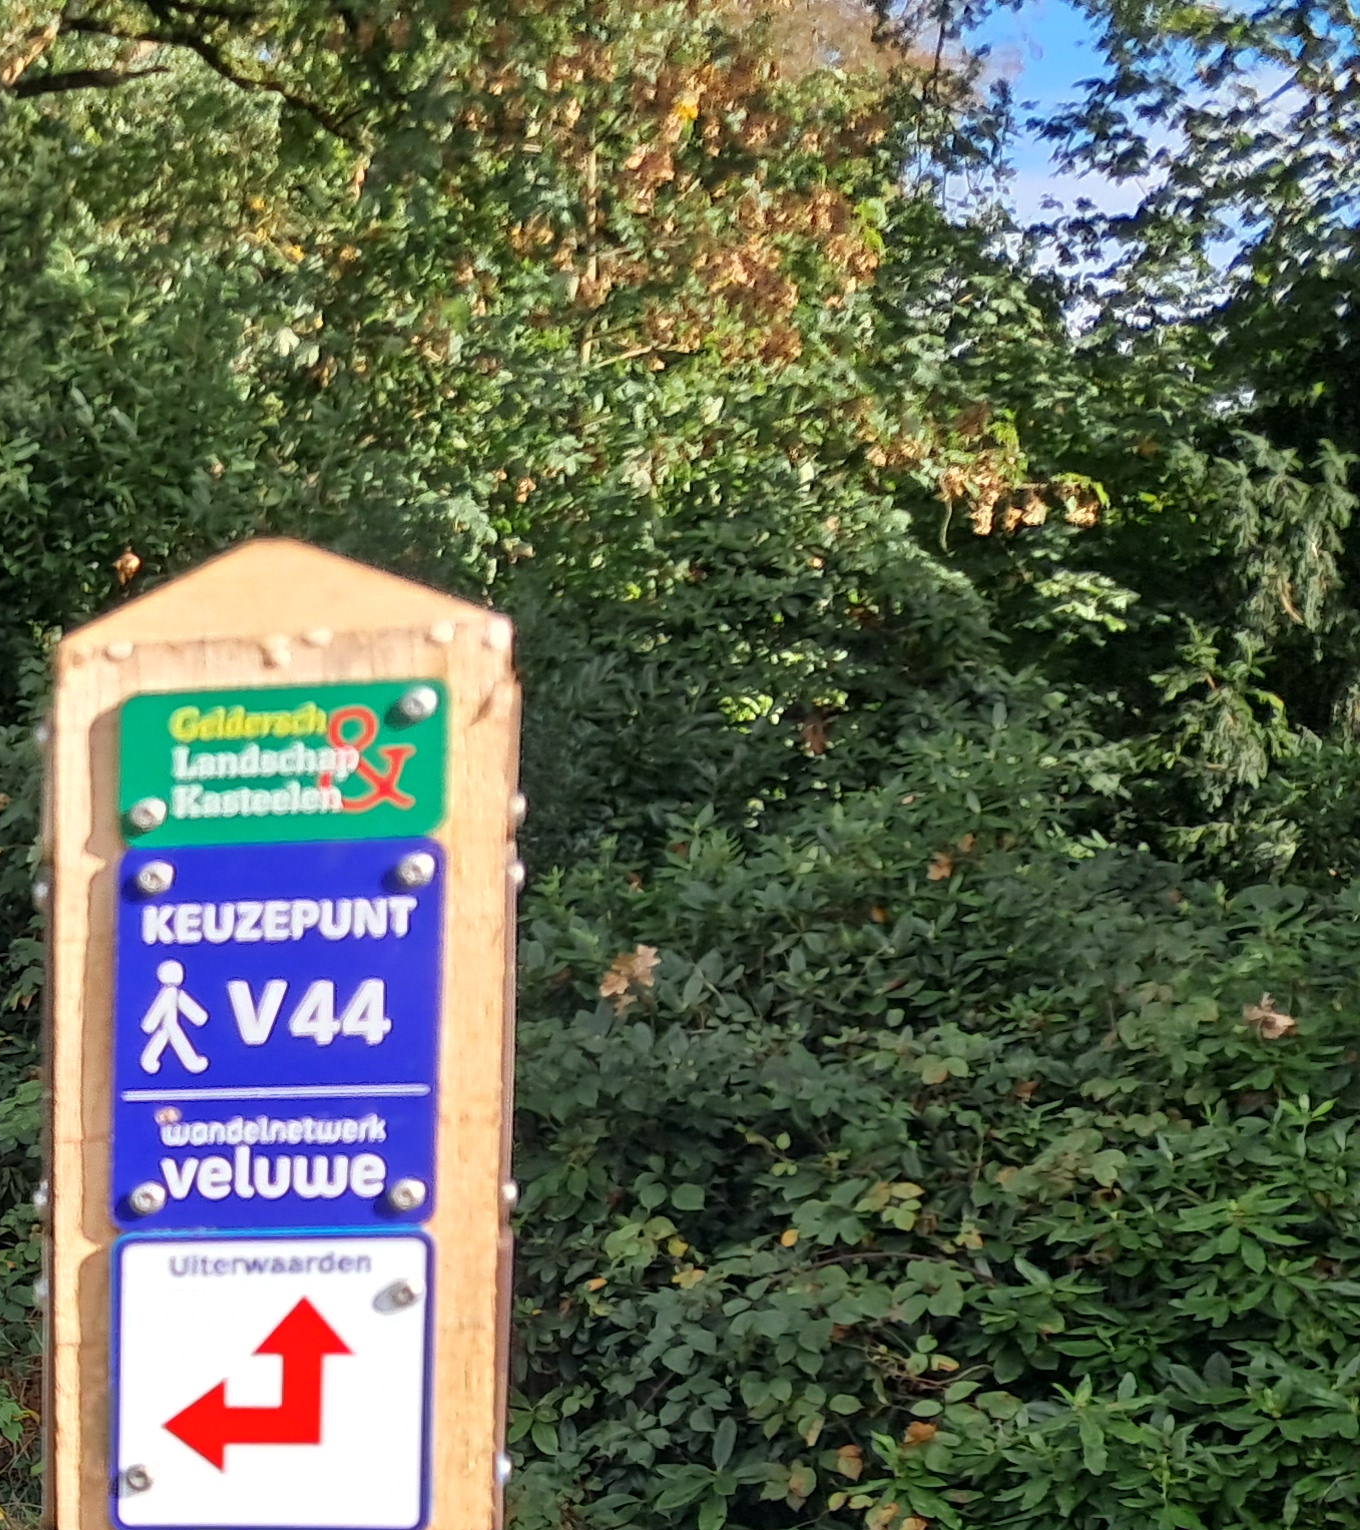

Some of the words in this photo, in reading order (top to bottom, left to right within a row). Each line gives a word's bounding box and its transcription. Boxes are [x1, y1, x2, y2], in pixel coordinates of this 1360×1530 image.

[169, 701, 327, 742] Geldersch
[171, 742, 359, 782] Landschap
[171, 780, 344, 818] Kasteelen
[141, 896, 418, 945] KEUZEPUNT
[226, 977, 392, 1046] V44
[159, 1113, 387, 1146] wandelnetwerk
[159, 1145, 387, 1199] veluwe
[169, 1253, 372, 1276] Uiterwaarden
